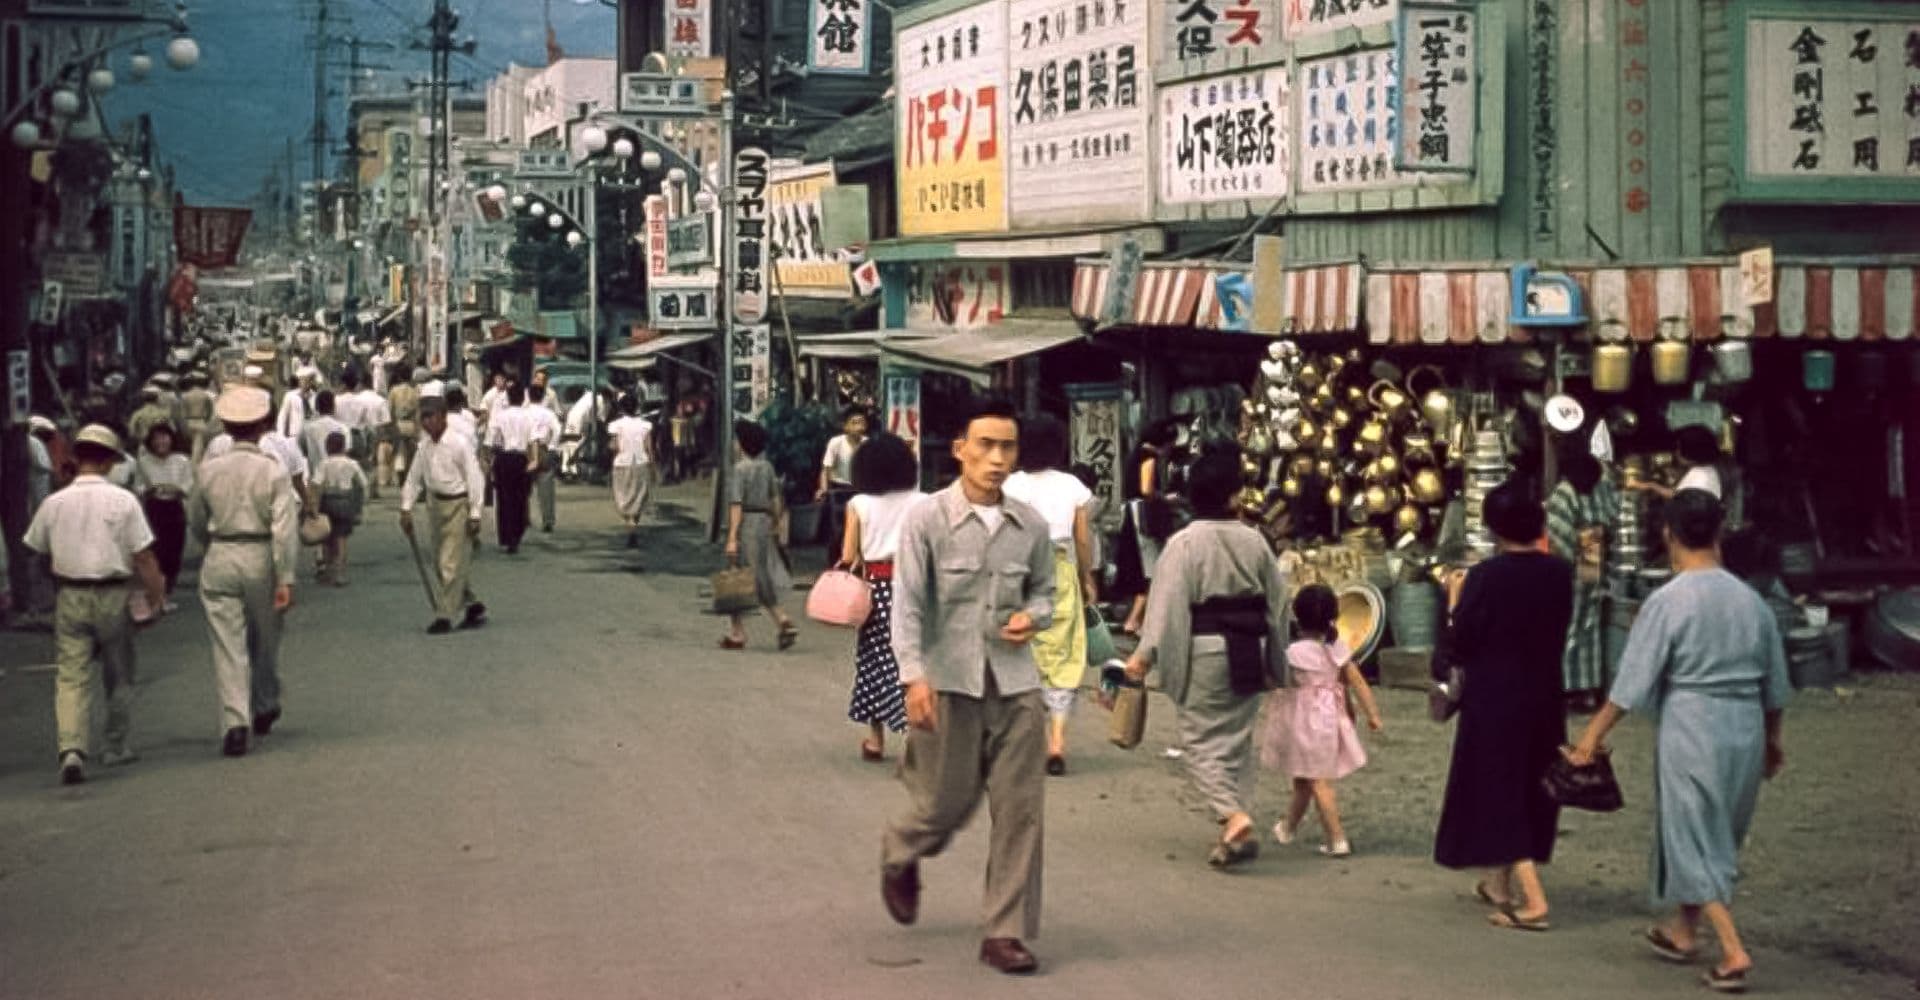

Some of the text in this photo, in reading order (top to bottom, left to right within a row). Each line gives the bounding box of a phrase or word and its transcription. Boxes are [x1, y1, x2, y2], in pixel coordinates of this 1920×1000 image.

[1015, 45, 1136, 123] 久保田薬局
[1849, 28, 1879, 172] 石工用
[905, 86, 997, 169] パチンコ
[1177, 101, 1275, 172] 山下陶器店
